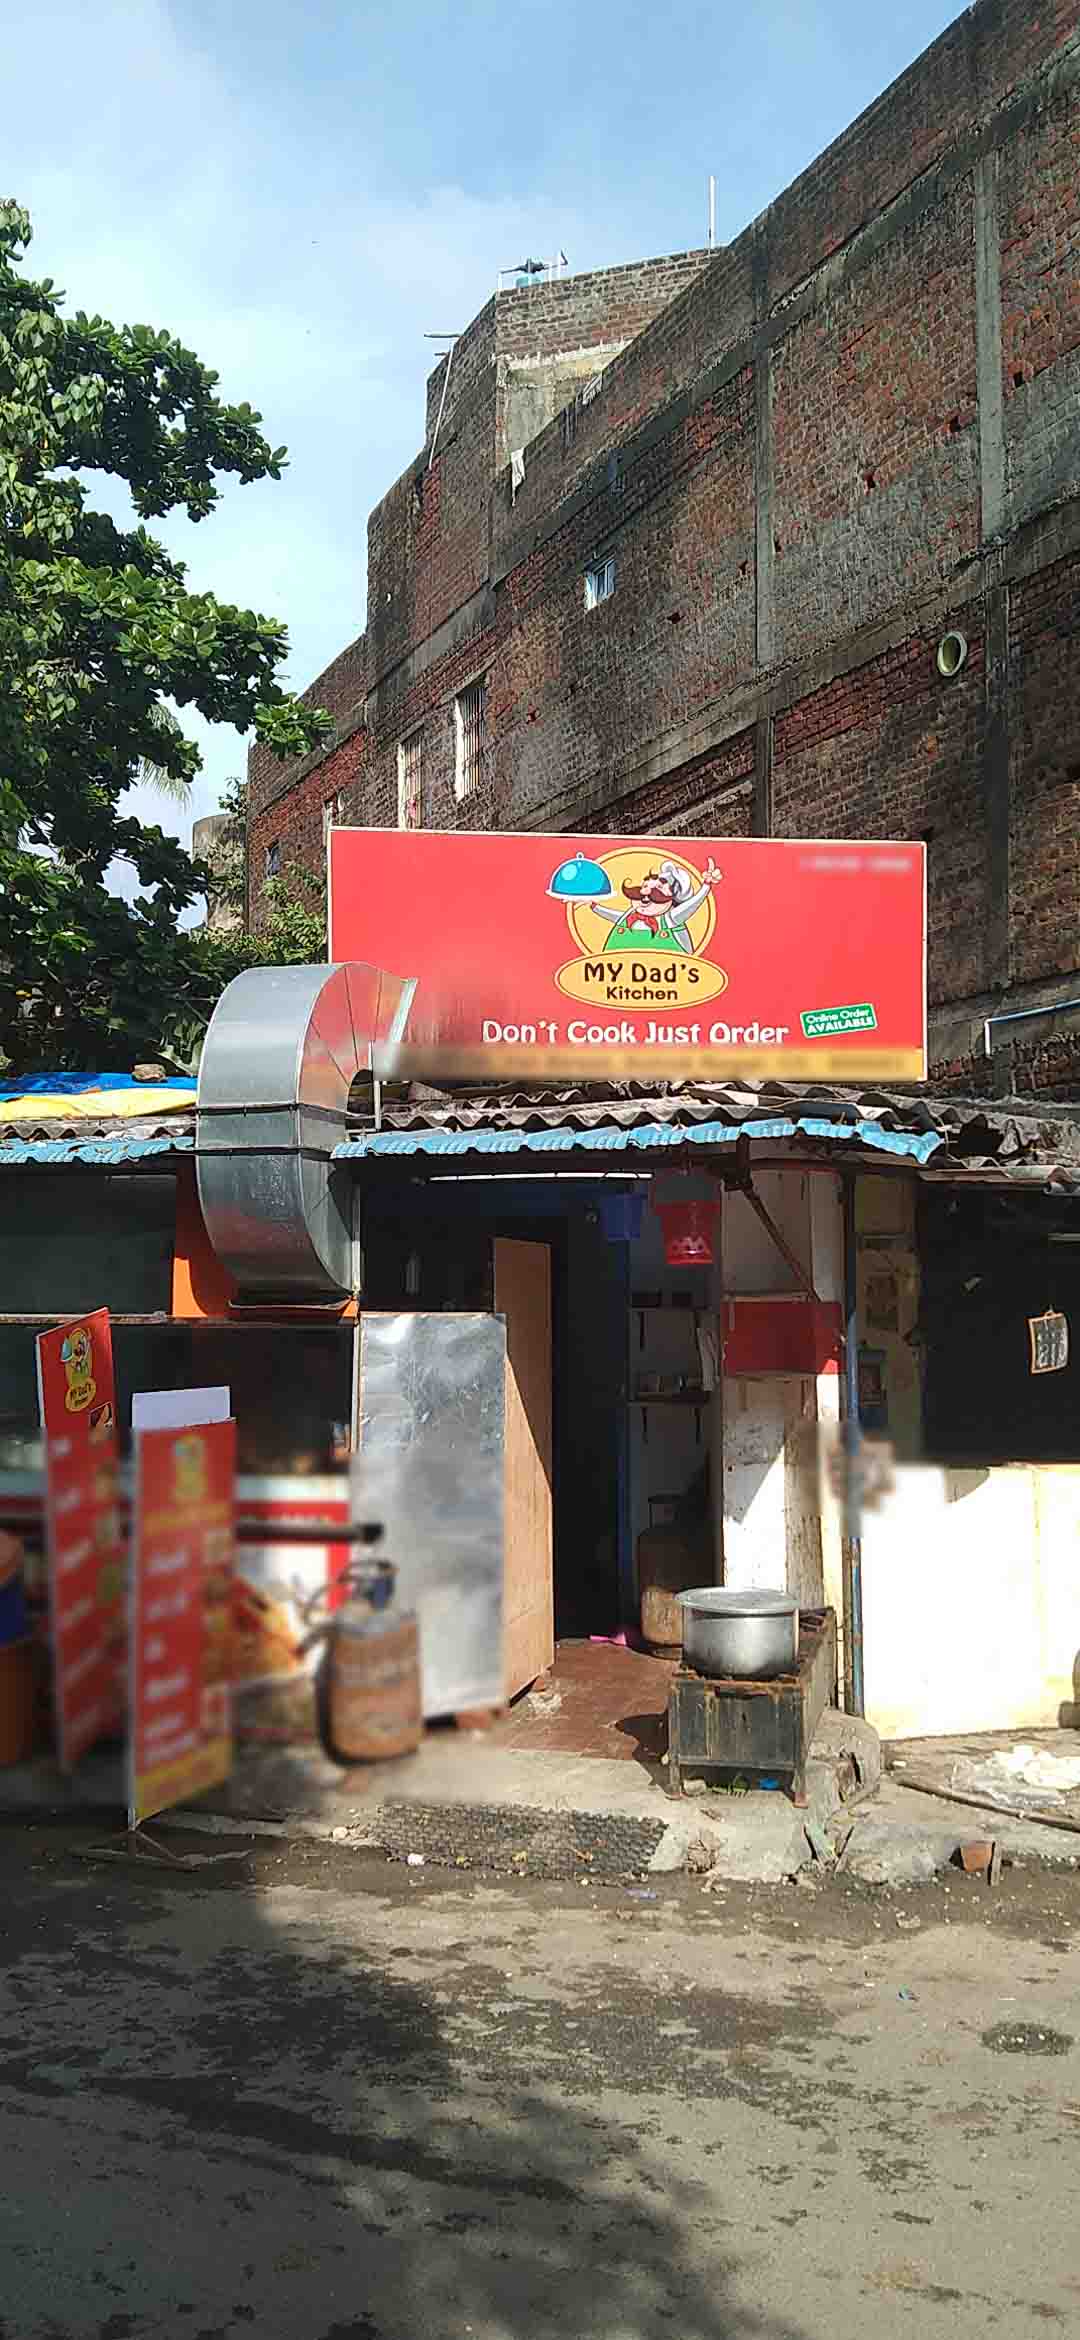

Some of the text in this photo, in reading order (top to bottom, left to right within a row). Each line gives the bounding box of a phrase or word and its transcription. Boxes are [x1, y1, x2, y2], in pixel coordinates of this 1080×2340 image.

[584, 962, 700, 984] MY Dad's
[606, 985, 678, 1001] Kitchen
[805, 1008, 870, 1024] Online Order
[807, 1015, 874, 1034] AVAILABLE
[481, 1020, 790, 1045] Don't Cook Just Order
